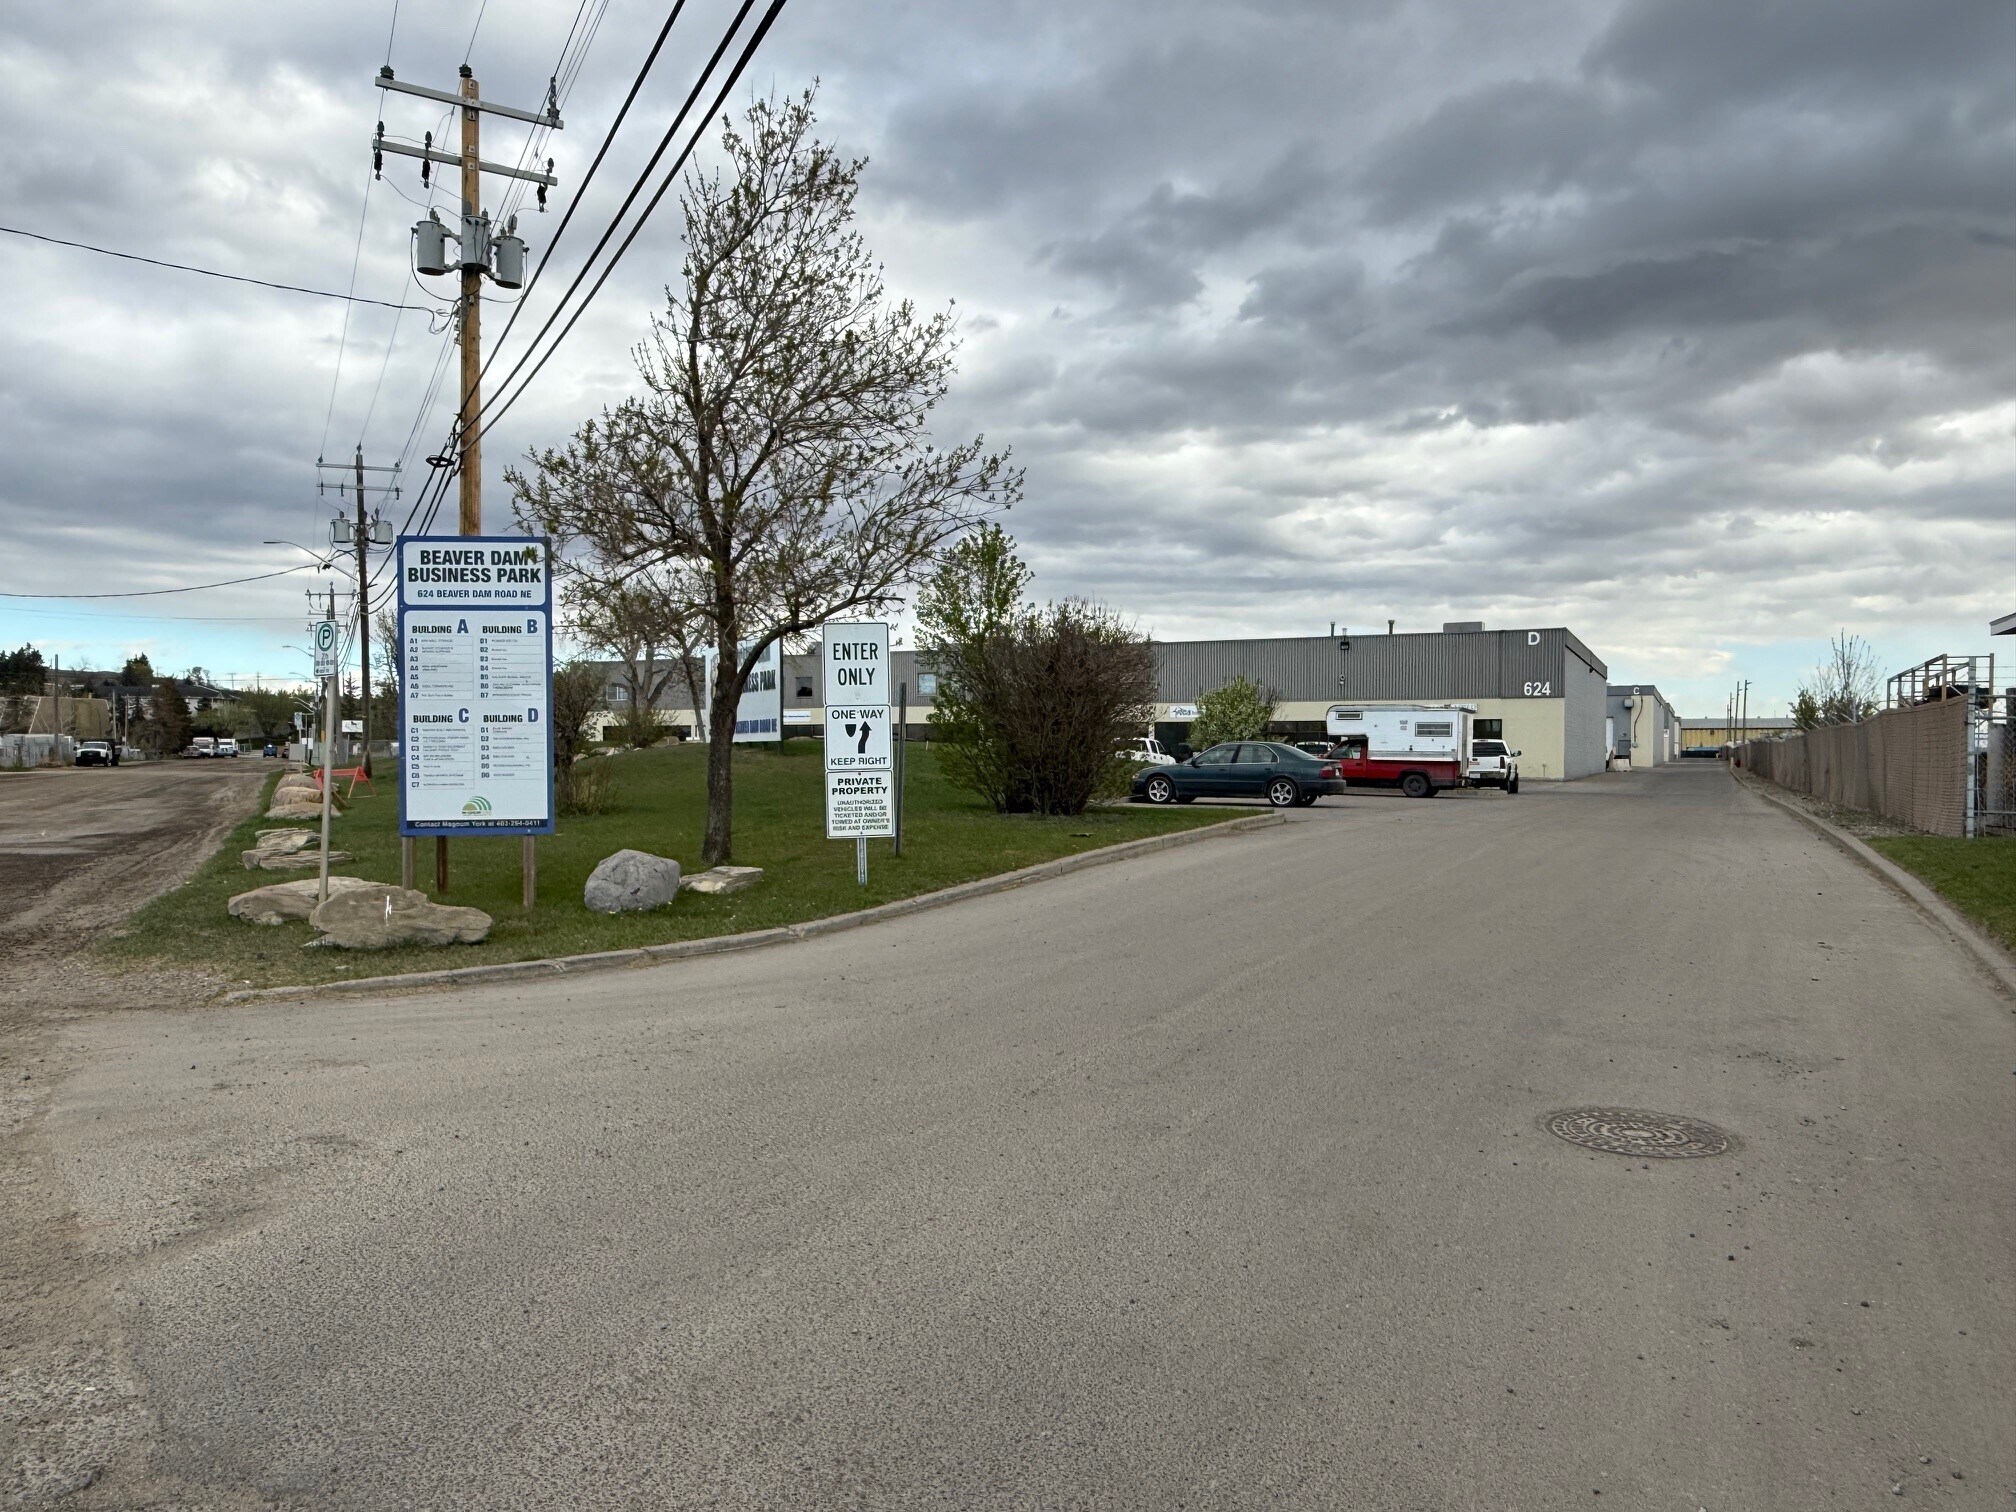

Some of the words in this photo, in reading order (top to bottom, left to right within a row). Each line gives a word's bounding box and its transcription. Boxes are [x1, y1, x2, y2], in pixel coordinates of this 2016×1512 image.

[420, 550, 485, 566] BEAVER
[491, 550, 528, 566] DAM
[408, 568, 492, 582] BUSINESS
[497, 568, 542, 583] PARK
[418, 590, 434, 598] 624
[436, 590, 470, 598] BEAVER
[472, 590, 492, 598] DAM
[494, 590, 518, 598] ROAD
[520, 590, 532, 598] NE
[412, 626, 452, 634] BUILDING
[457, 619, 468, 634] A
[482, 626, 522, 634] BUILDING
[527, 619, 538, 634] B
[1528, 632, 1540, 646] D
[833, 642, 878, 660] ENTER
[760, 670, 776, 691] PARK
[838, 668, 876, 686] ONLY
[1524, 682, 1550, 696] 624
[458, 708, 470, 723] C
[484, 714, 522, 722] BUILDING
[528, 708, 538, 722] D
[832, 710, 856, 720] ONE
[860, 709, 884, 719] WAY
[830, 758, 856, 766] KEEP
[858, 756, 888, 765] RIGHT
[838, 777, 882, 786] PRIVATE
[832, 786, 888, 795] PROPERTY
